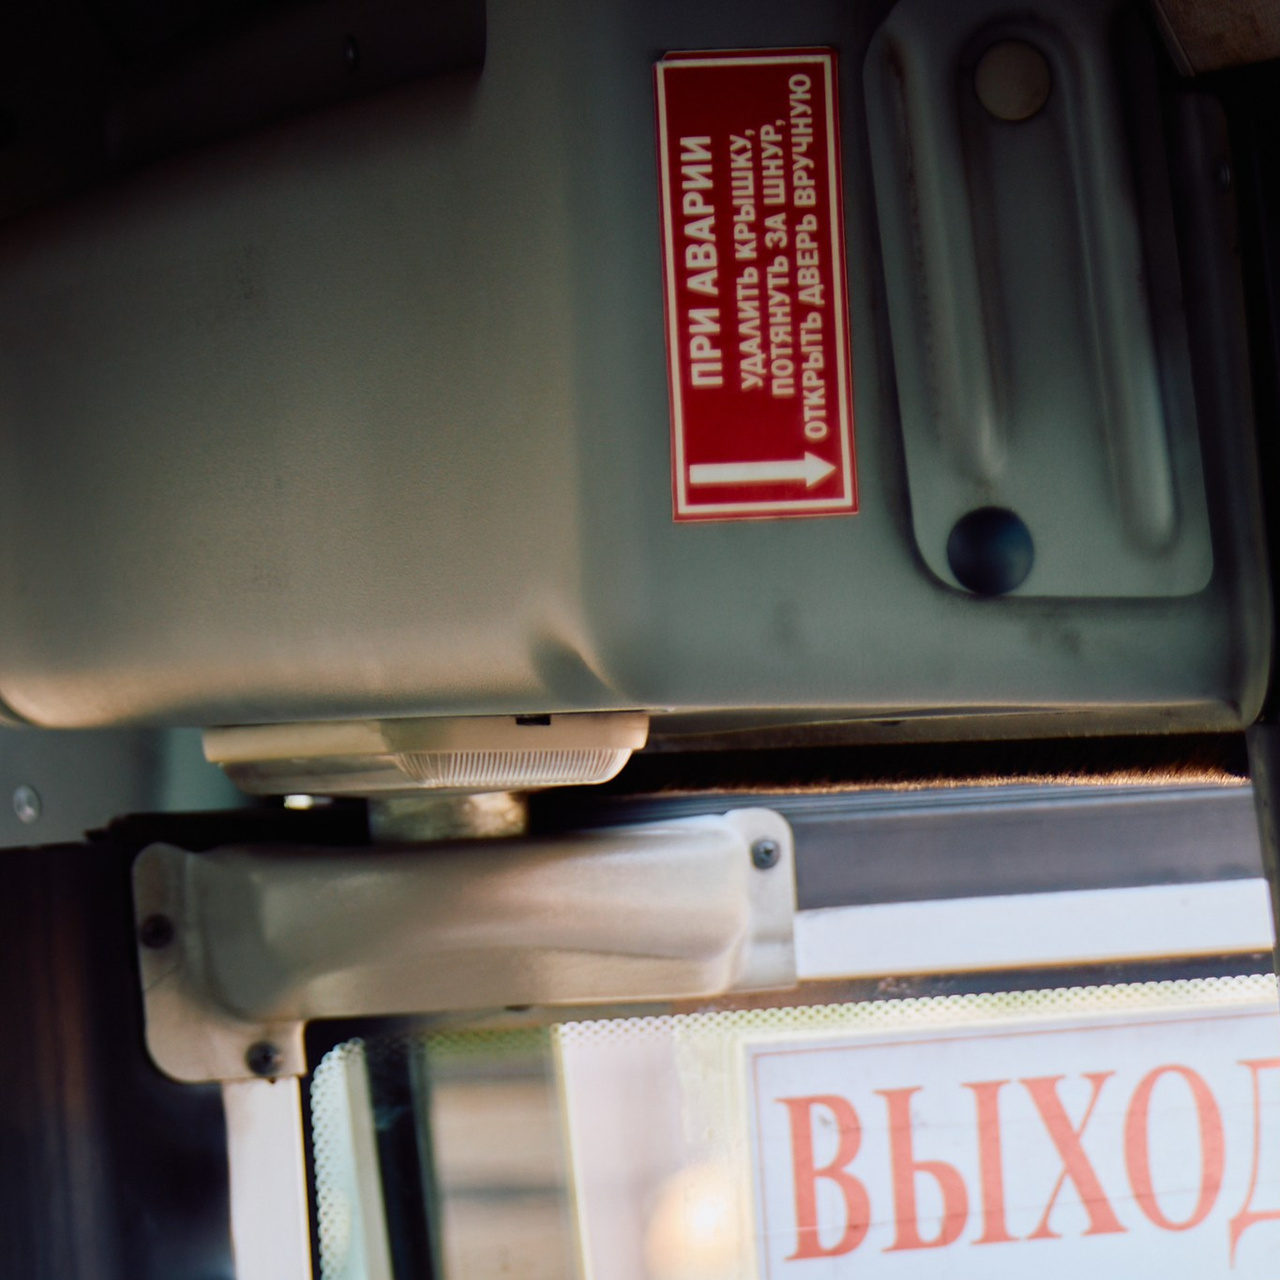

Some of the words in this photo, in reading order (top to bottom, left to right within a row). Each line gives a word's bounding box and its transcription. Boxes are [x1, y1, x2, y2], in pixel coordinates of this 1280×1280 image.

[730, 129, 757, 261] КРЫШКУ,
[760, 119, 786, 205] ШНУР,
[788, 74, 816, 206] ВРУЧНУЮ
[680, 136, 719, 296] АВАРИИ
[764, 212, 788, 249] ЗА
[795, 214, 825, 305] ДВЕРЬ
[688, 307, 723, 386] ПРИ
[736, 267, 767, 390] УДАЛИТЬ
[767, 255, 795, 395] ПОТЯНУТЬ
[800, 312, 828, 440] ОТКРЫТЬ
